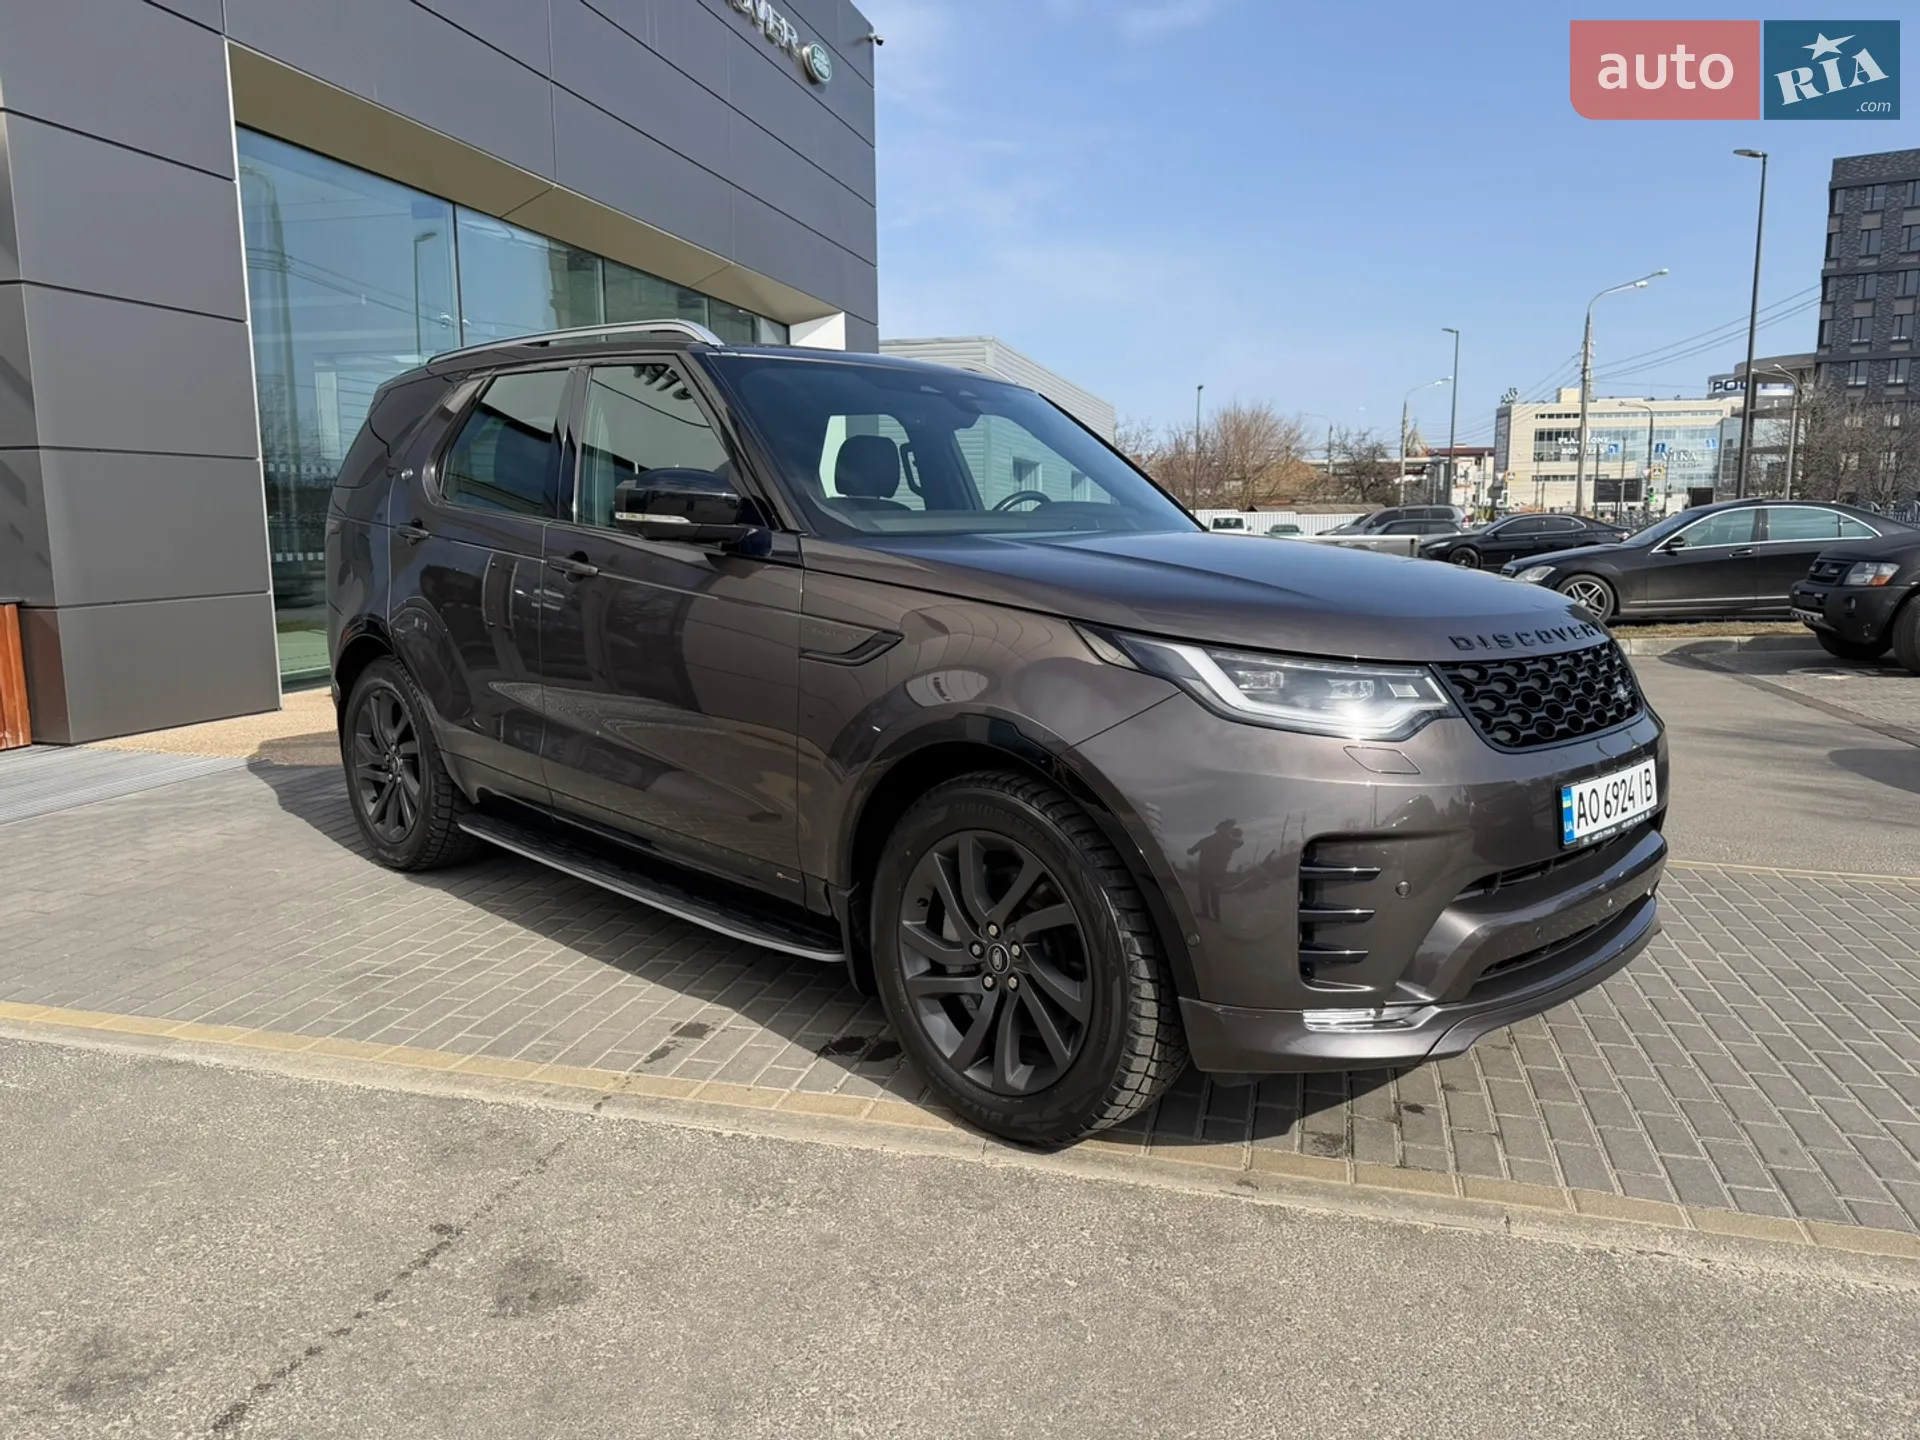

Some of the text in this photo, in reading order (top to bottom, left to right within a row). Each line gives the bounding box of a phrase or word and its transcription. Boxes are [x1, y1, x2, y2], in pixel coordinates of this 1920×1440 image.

[1577, 788, 1600, 829] AO
[1604, 774, 1635, 819] 6924
[1639, 768, 1653, 805] IB
